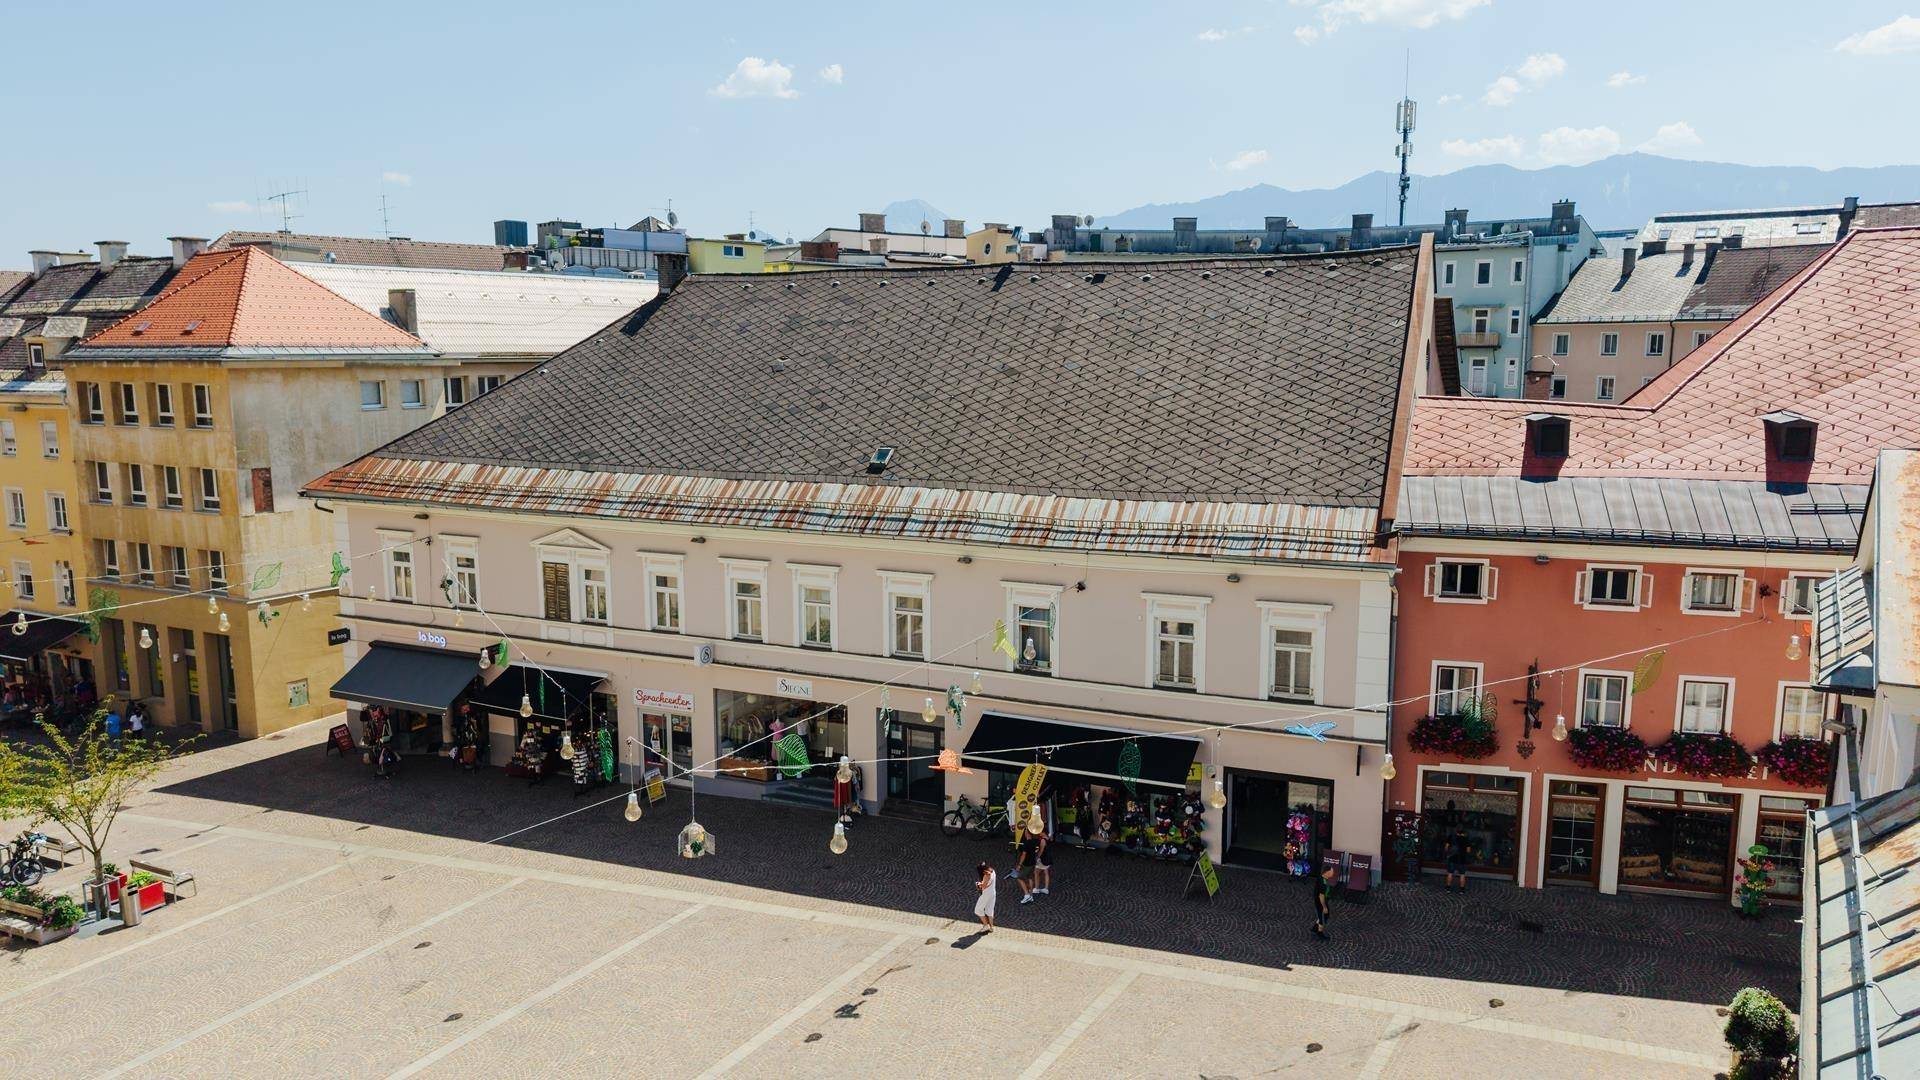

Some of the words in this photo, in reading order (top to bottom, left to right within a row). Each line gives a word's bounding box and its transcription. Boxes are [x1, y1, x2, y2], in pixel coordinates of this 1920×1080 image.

[635, 689, 692, 706] Sprachcenter
[1021, 764, 1037, 795] DESIGNER
[1032, 765, 1047, 791] OUTLET
